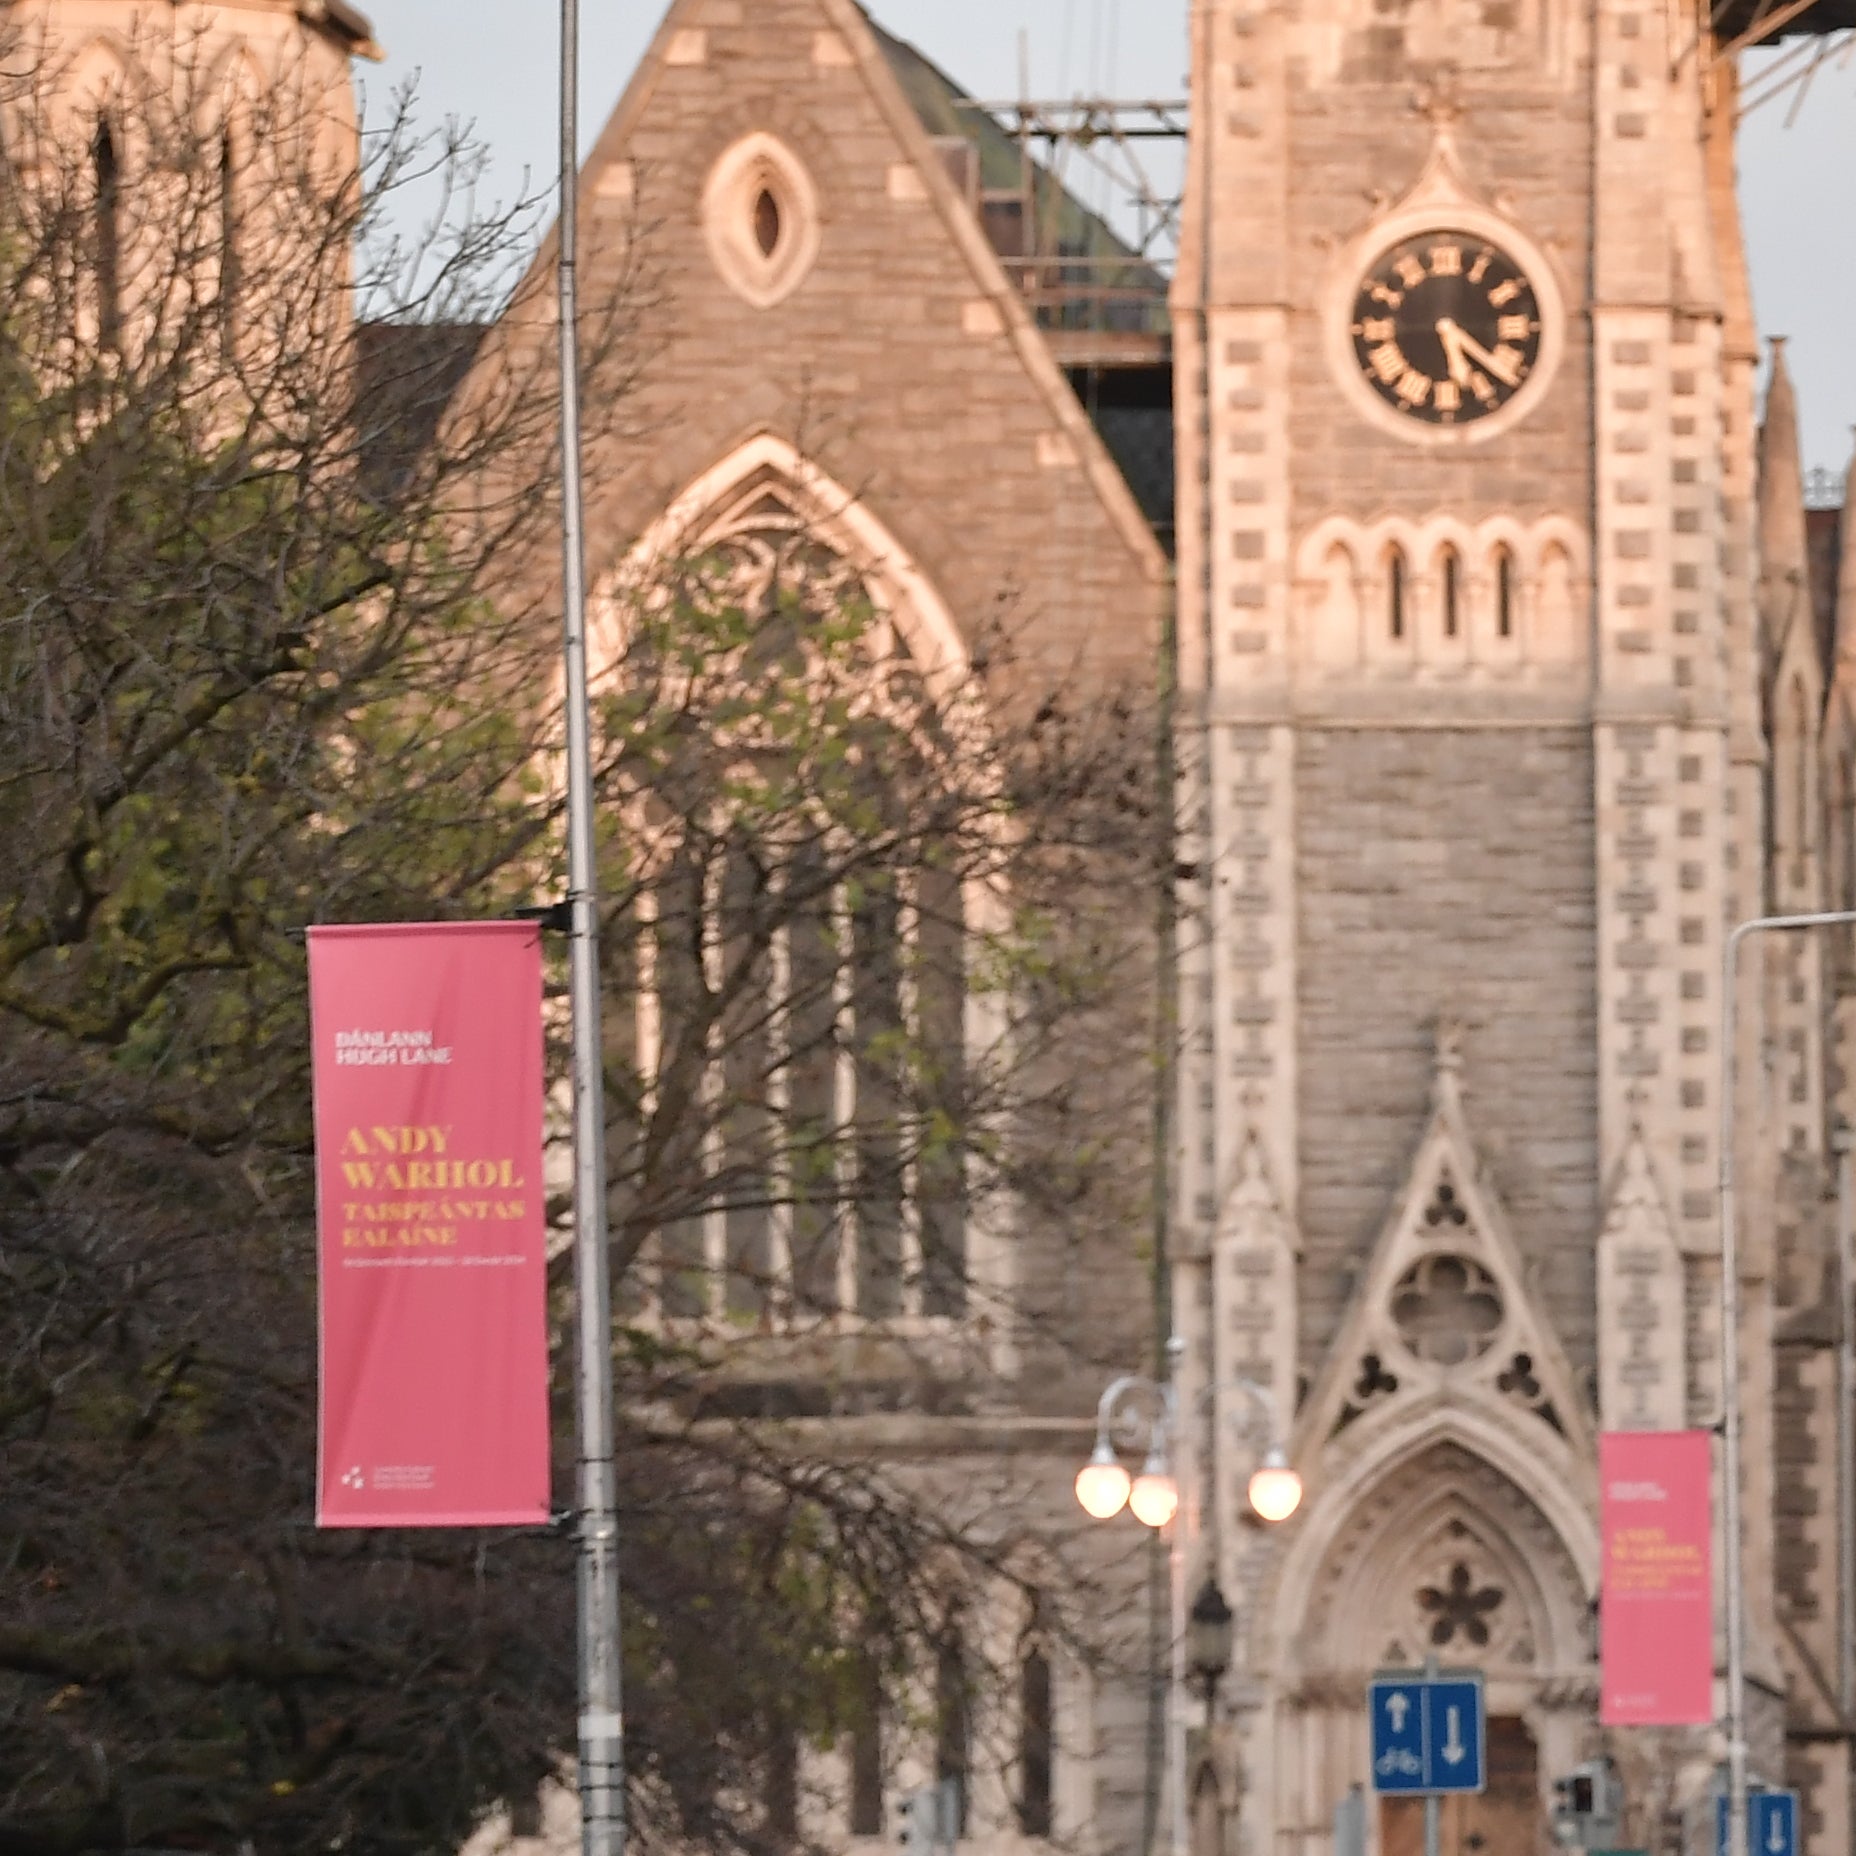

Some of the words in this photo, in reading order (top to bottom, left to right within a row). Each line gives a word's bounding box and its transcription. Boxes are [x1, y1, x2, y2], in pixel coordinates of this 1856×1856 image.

[336, 1047, 398, 1065] HUGH
[401, 1046, 453, 1065] LANE
[340, 1125, 452, 1154] ANDY
[342, 1159, 525, 1190] WARHOL
[343, 1196, 526, 1222] TAISPEÁNTAS
